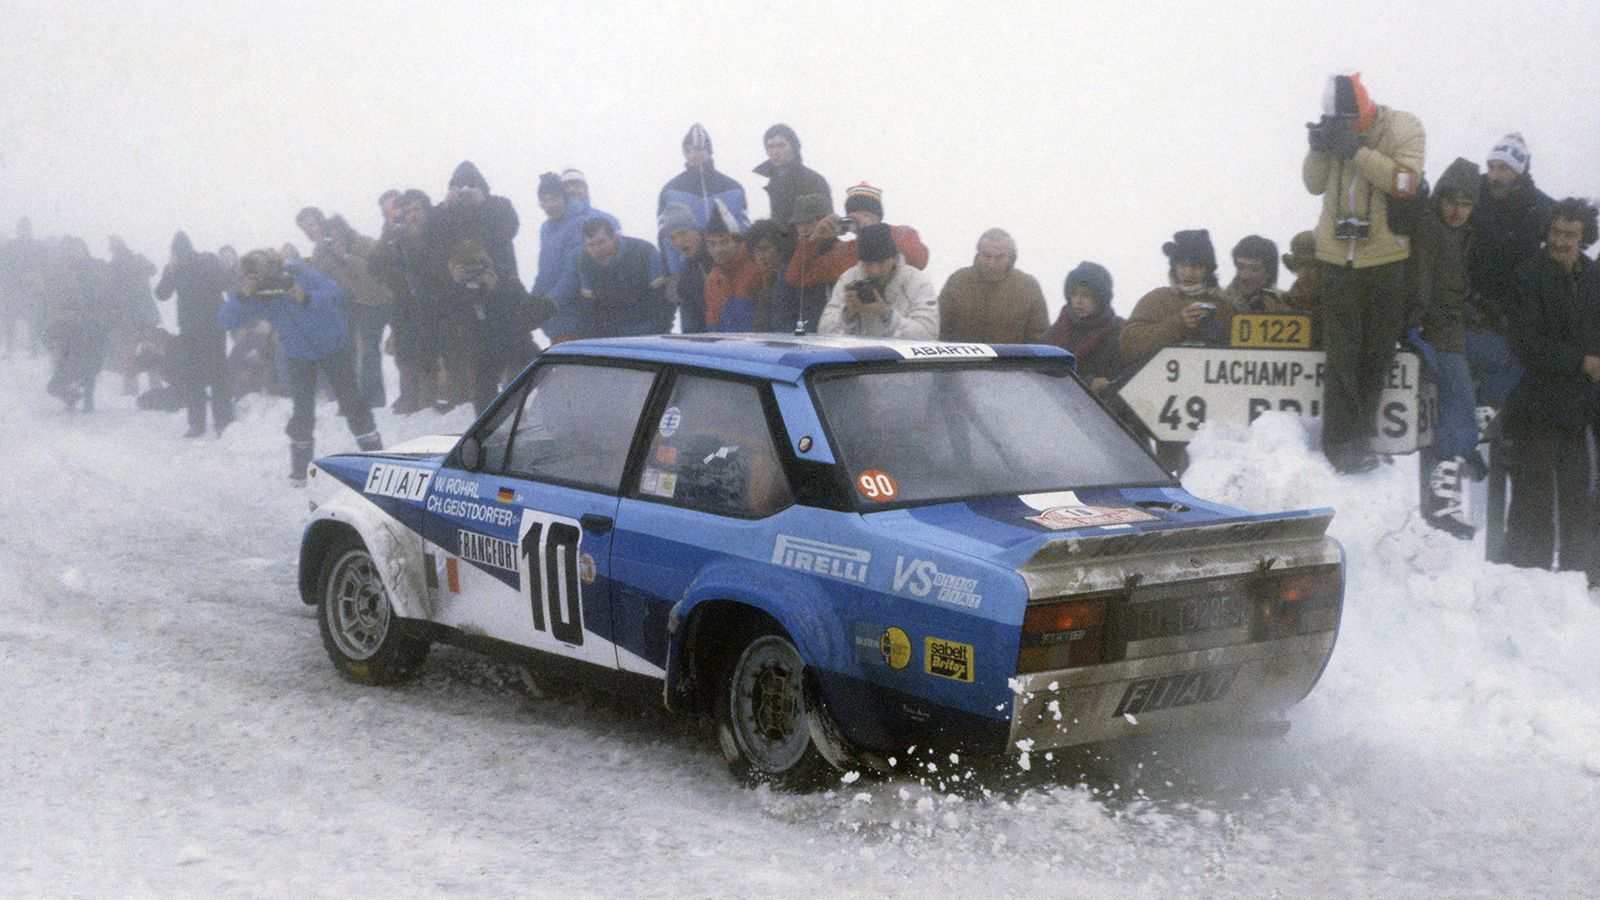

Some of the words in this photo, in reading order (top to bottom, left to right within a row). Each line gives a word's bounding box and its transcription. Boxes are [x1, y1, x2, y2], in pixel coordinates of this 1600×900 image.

[1239, 319, 1250, 343] D
[1259, 319, 1302, 343] 122
[910, 345, 985, 356] ABARTH
[1166, 359, 1180, 383] 9
[1158, 395, 1207, 431] 49
[368, 466, 429, 497] FIAT
[860, 474, 894, 498] 90
[443, 497, 513, 527] GEISTDORFER
[771, 533, 872, 583] PIRELLI
[521, 521, 584, 647] 10
[892, 555, 938, 598] VS
[940, 588, 981, 607] FIAT
[931, 641, 967, 660] sabelt
